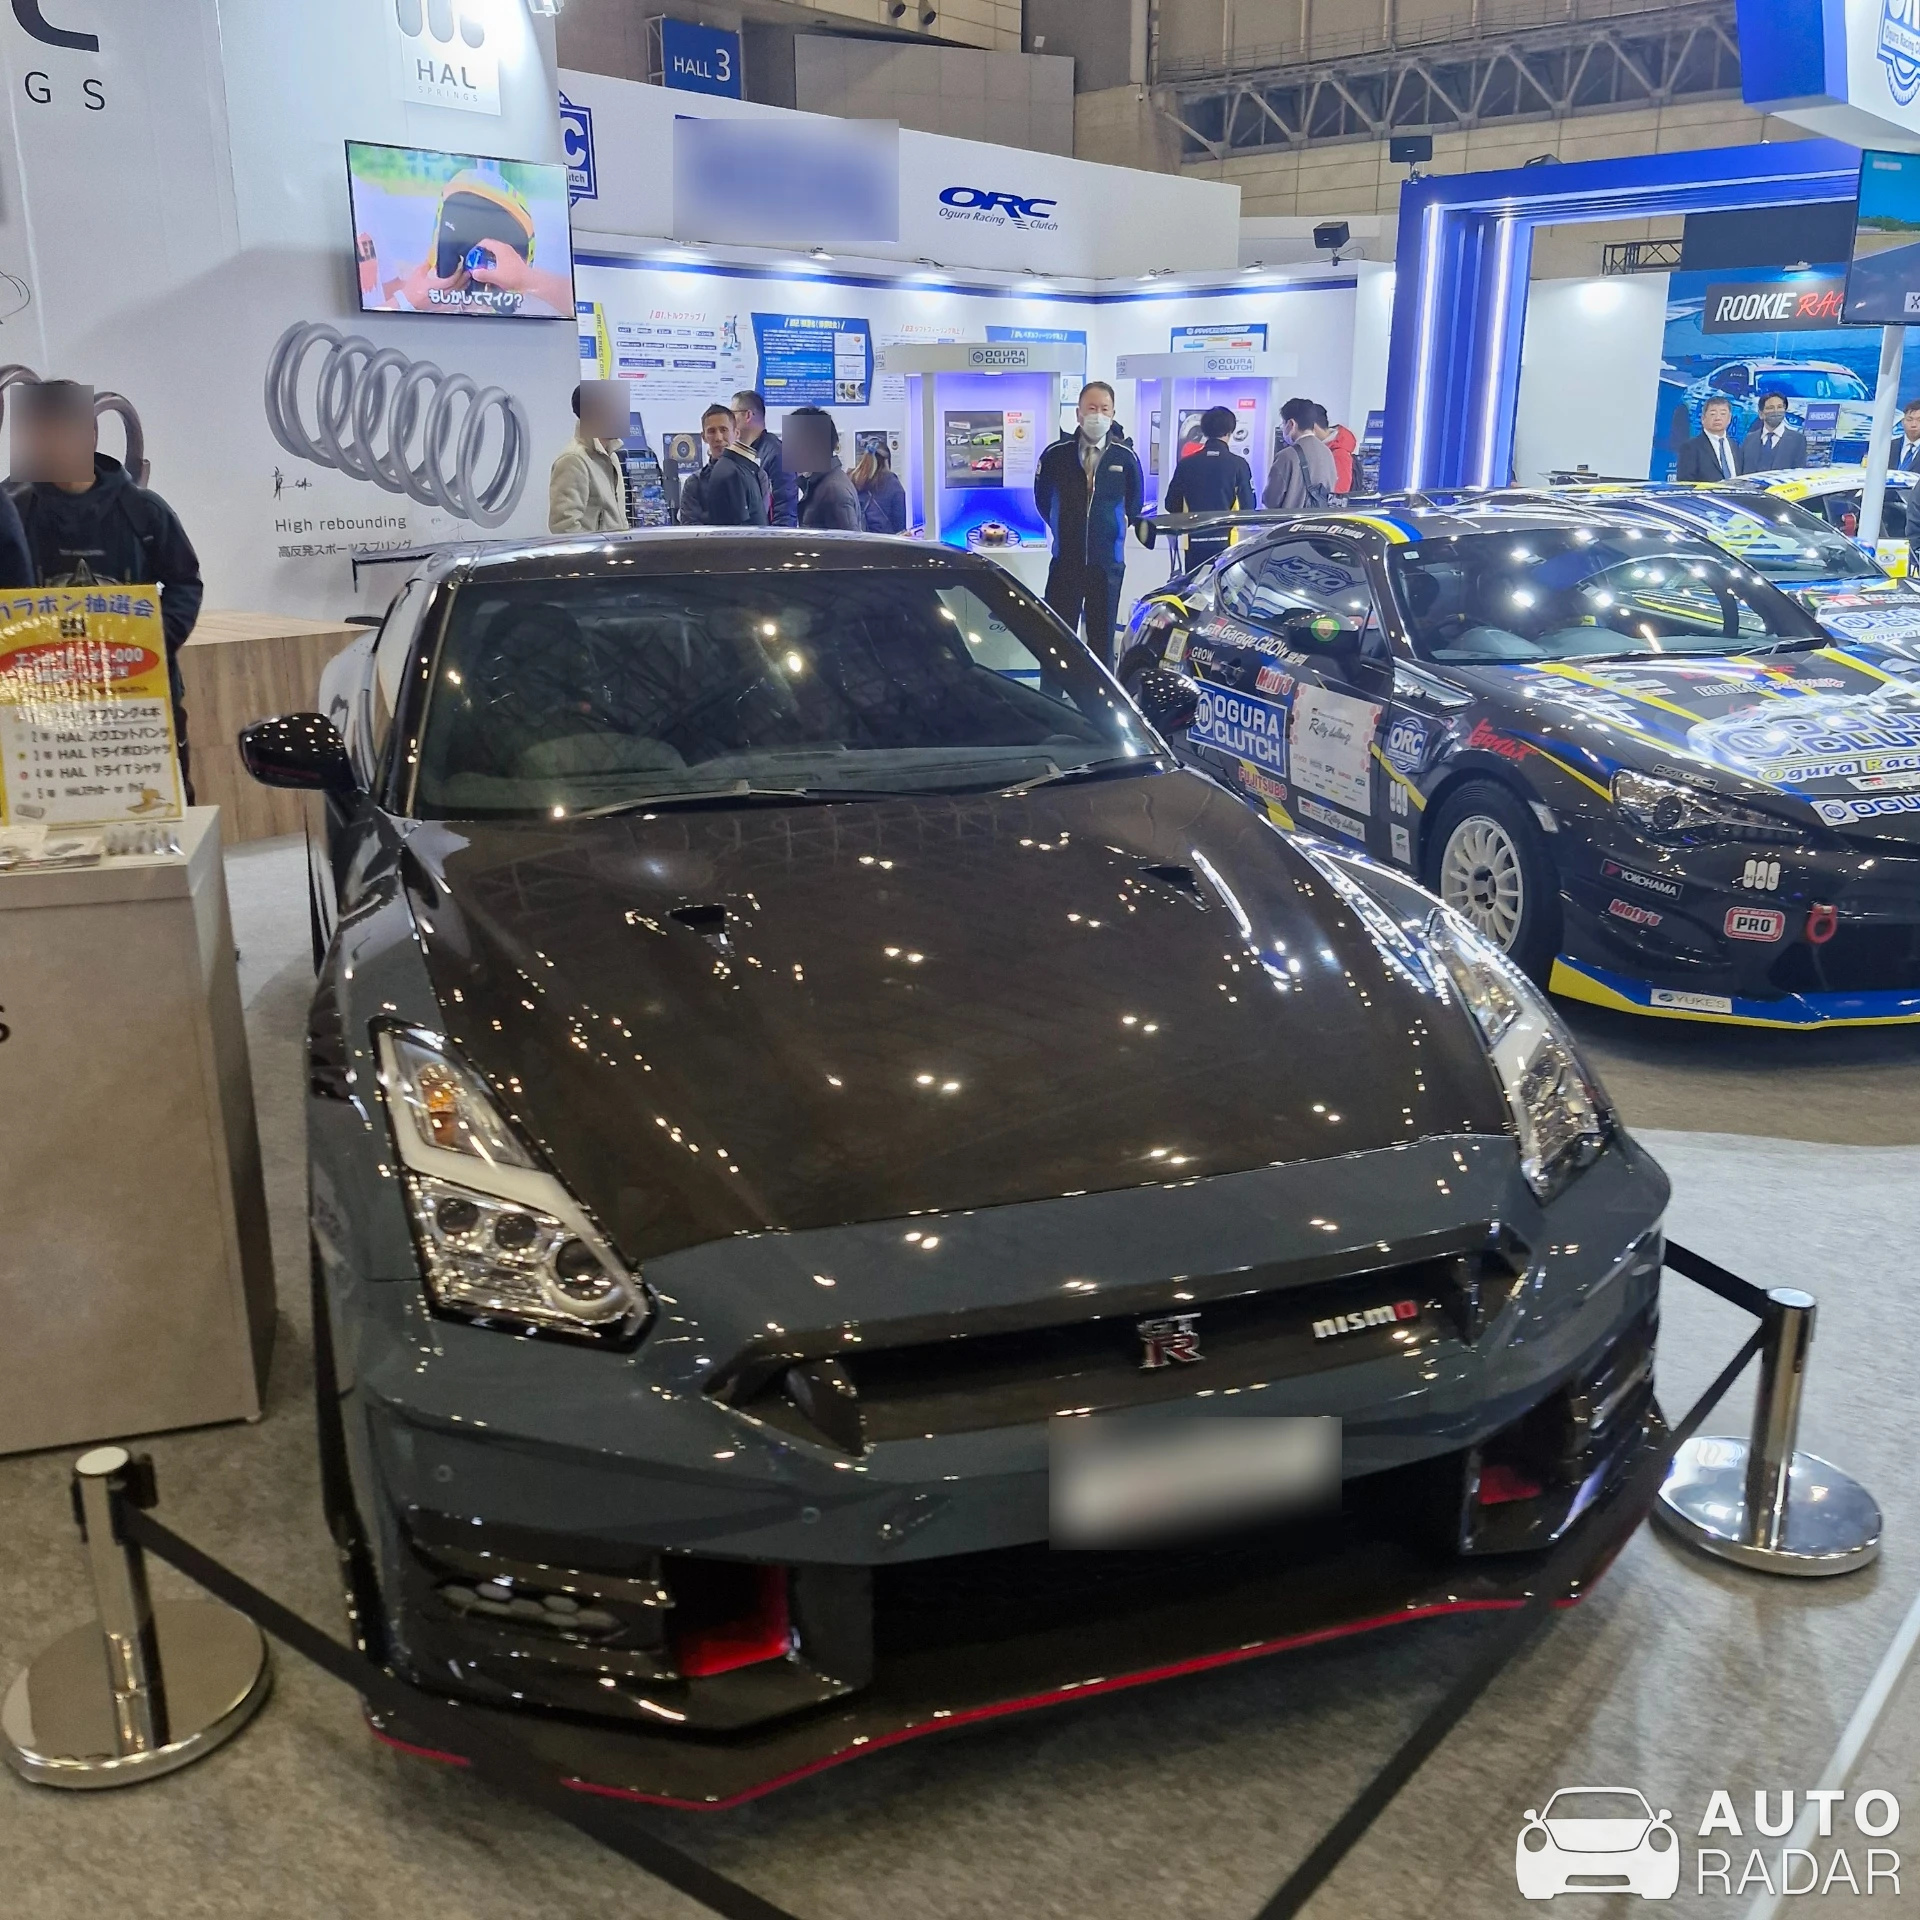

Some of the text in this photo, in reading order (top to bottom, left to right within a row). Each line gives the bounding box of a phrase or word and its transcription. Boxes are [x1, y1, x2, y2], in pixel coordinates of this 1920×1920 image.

[417, 59, 477, 89] HAL
[674, 48, 731, 81] HALL 3
[418, 86, 478, 102] SPRINGS
[939, 187, 1058, 218] ORC
[939, 207, 1059, 231] Ogura Racing Clutch
[428, 289, 524, 308] もしかしてマイク?
[1715, 292, 1797, 322] ROOKIE
[275, 516, 407, 534] High rebounding
[1214, 695, 1280, 739] OGURA
[56, 732, 86, 742] HAL
[1214, 720, 1280, 766] CLUTCH
[1390, 727, 1424, 755] ORC
[57, 749, 88, 759] HAL
[59, 767, 88, 779] HAL
[1239, 766, 1287, 800] FUJITSUBO
[1763, 763, 1853, 782] Ogura
[1621, 870, 1677, 896] YOKOHAMA
[1746, 873, 1776, 884] HAL
[1608, 899, 1663, 926] Moty's
[1736, 916, 1771, 932] PRO
[1312, 1300, 1418, 1339] nismo
